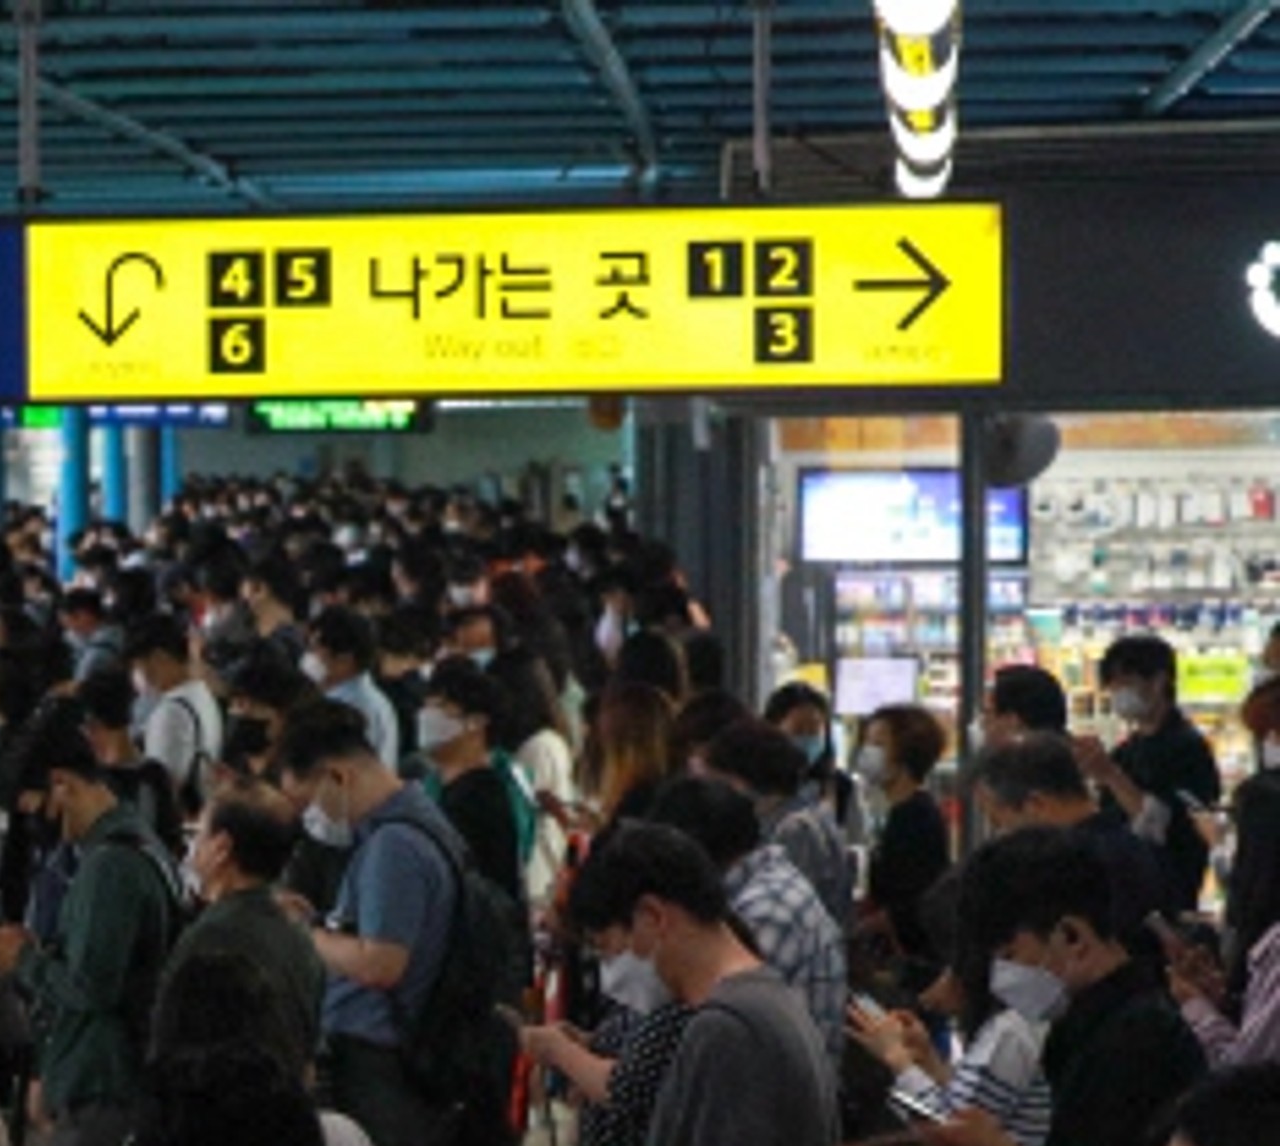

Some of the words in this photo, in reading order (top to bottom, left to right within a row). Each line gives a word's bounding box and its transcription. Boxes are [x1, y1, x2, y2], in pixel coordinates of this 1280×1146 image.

[219, 257, 252, 301] 4
[286, 256, 318, 299] 5
[368, 252, 552, 320] 나가는
[594, 251, 651, 320] 곳
[702, 247, 725, 291] 1
[768, 246, 800, 289] 2
[219, 322, 252, 365] 6
[424, 334, 486, 362] Way
[495, 334, 542, 359] out
[768, 311, 800, 356] 3
